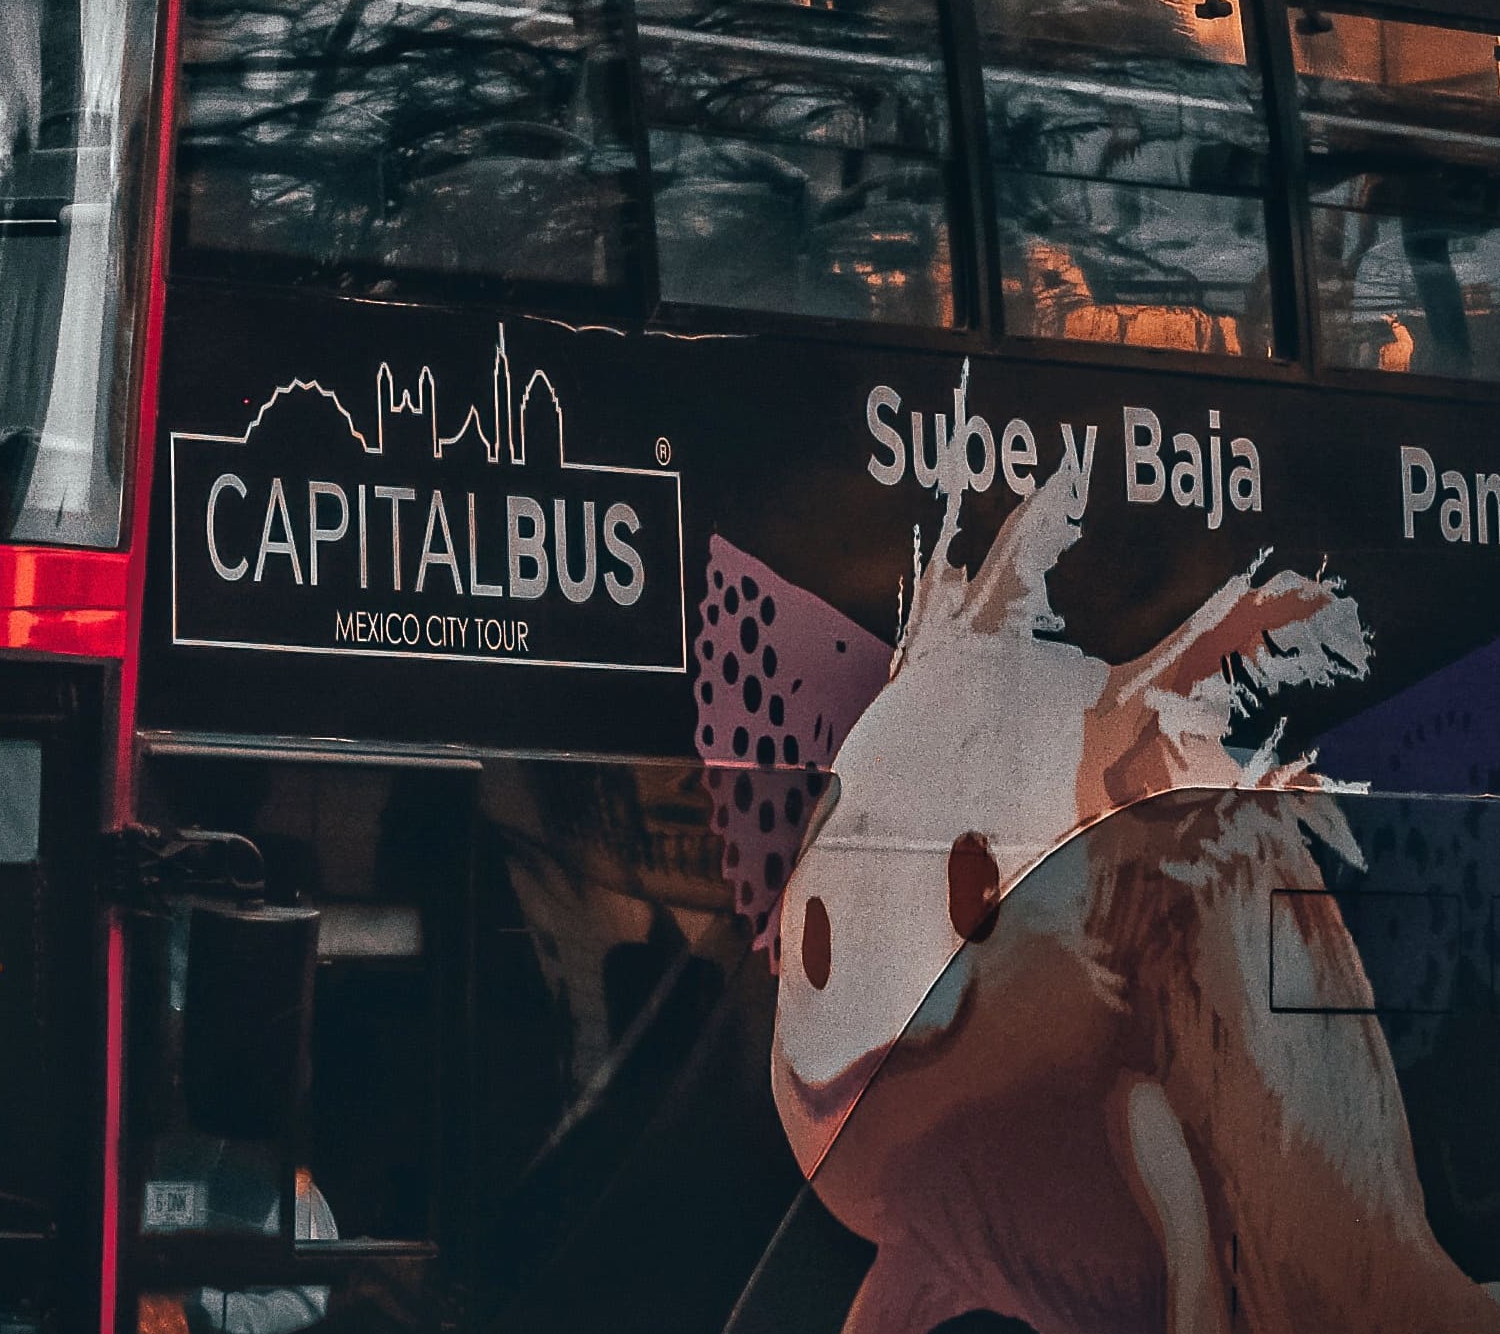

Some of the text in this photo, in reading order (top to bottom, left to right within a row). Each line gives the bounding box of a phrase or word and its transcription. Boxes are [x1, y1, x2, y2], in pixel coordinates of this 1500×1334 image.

[866, 386, 1263, 530] Sube y Baja
[206, 473, 645, 606] CAPITALBUS
[334, 610, 530, 652] MEXICO CITY TOUR
